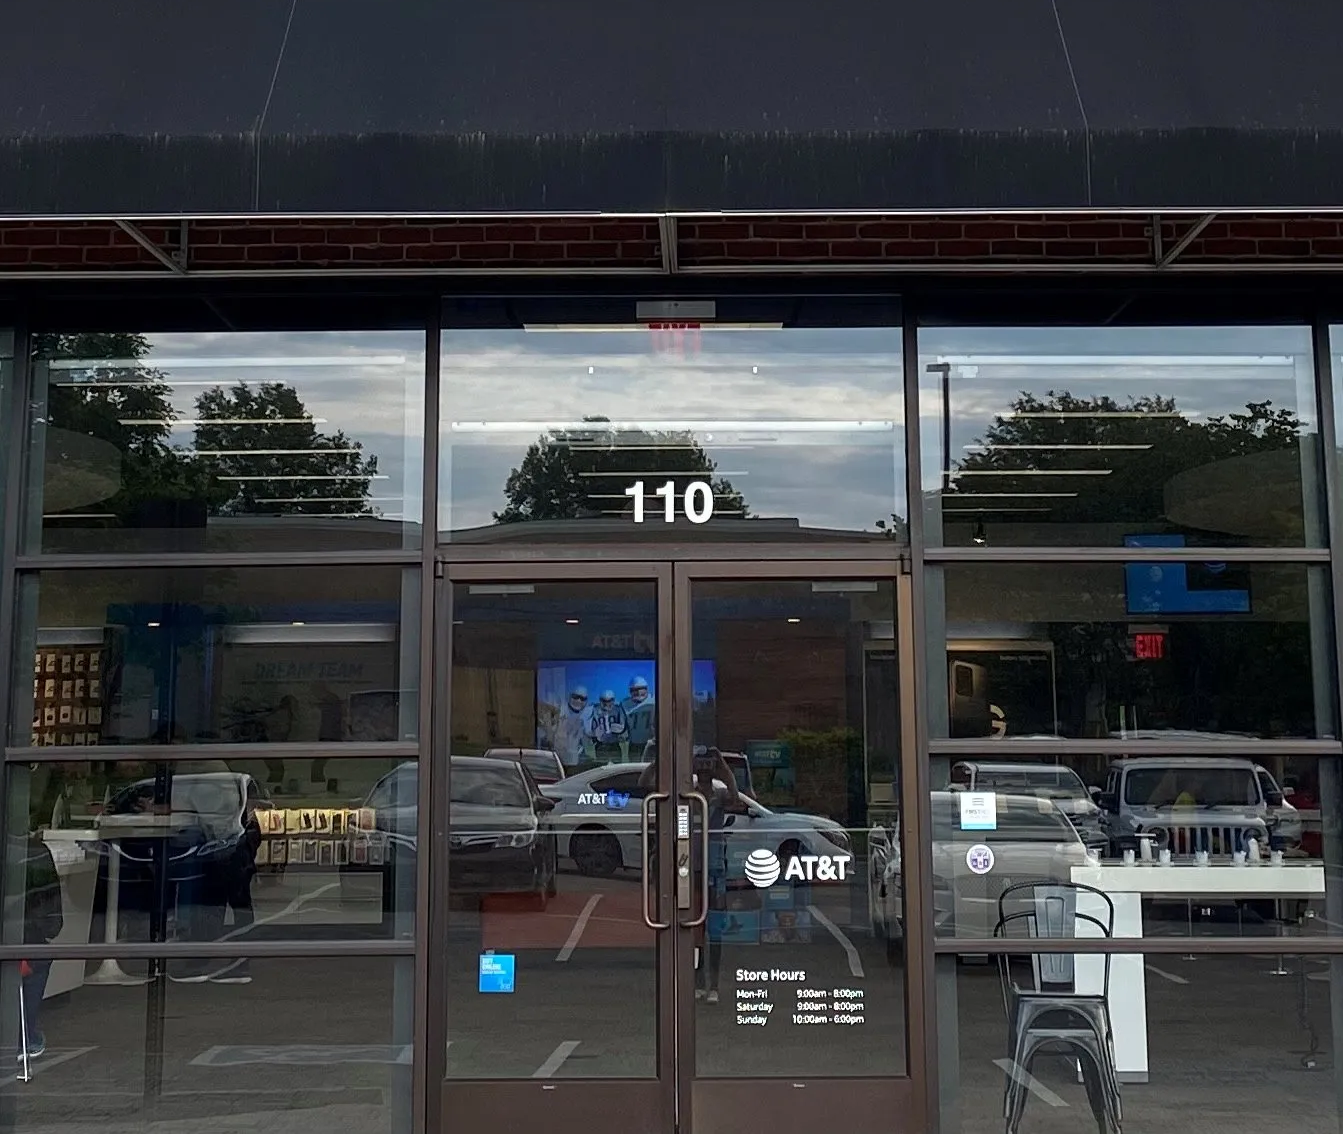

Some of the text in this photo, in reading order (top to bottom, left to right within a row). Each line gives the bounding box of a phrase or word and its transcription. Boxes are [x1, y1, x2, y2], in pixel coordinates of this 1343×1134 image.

[624, 481, 715, 525] 110
[591, 634, 632, 649] AT&T
[1135, 634, 1164, 658] EXIT
[577, 789, 630, 809] AT&T tv
[784, 855, 851, 881] AT&T
[736, 968, 807, 982] Store Hours
[736, 989, 768, 999] Mon-Fri
[796, 989, 827, 999] 9:00am
[833, 988, 865, 1000] 8:00pm
[736, 1002, 774, 1014] Saturday
[796, 1002, 827, 1011] 9:00am
[833, 1001, 865, 1012] 8:00pm
[736, 1015, 768, 1026] Sunday
[792, 1015, 828, 1024] 10:00am
[833, 1014, 865, 1025] 6:00pm
